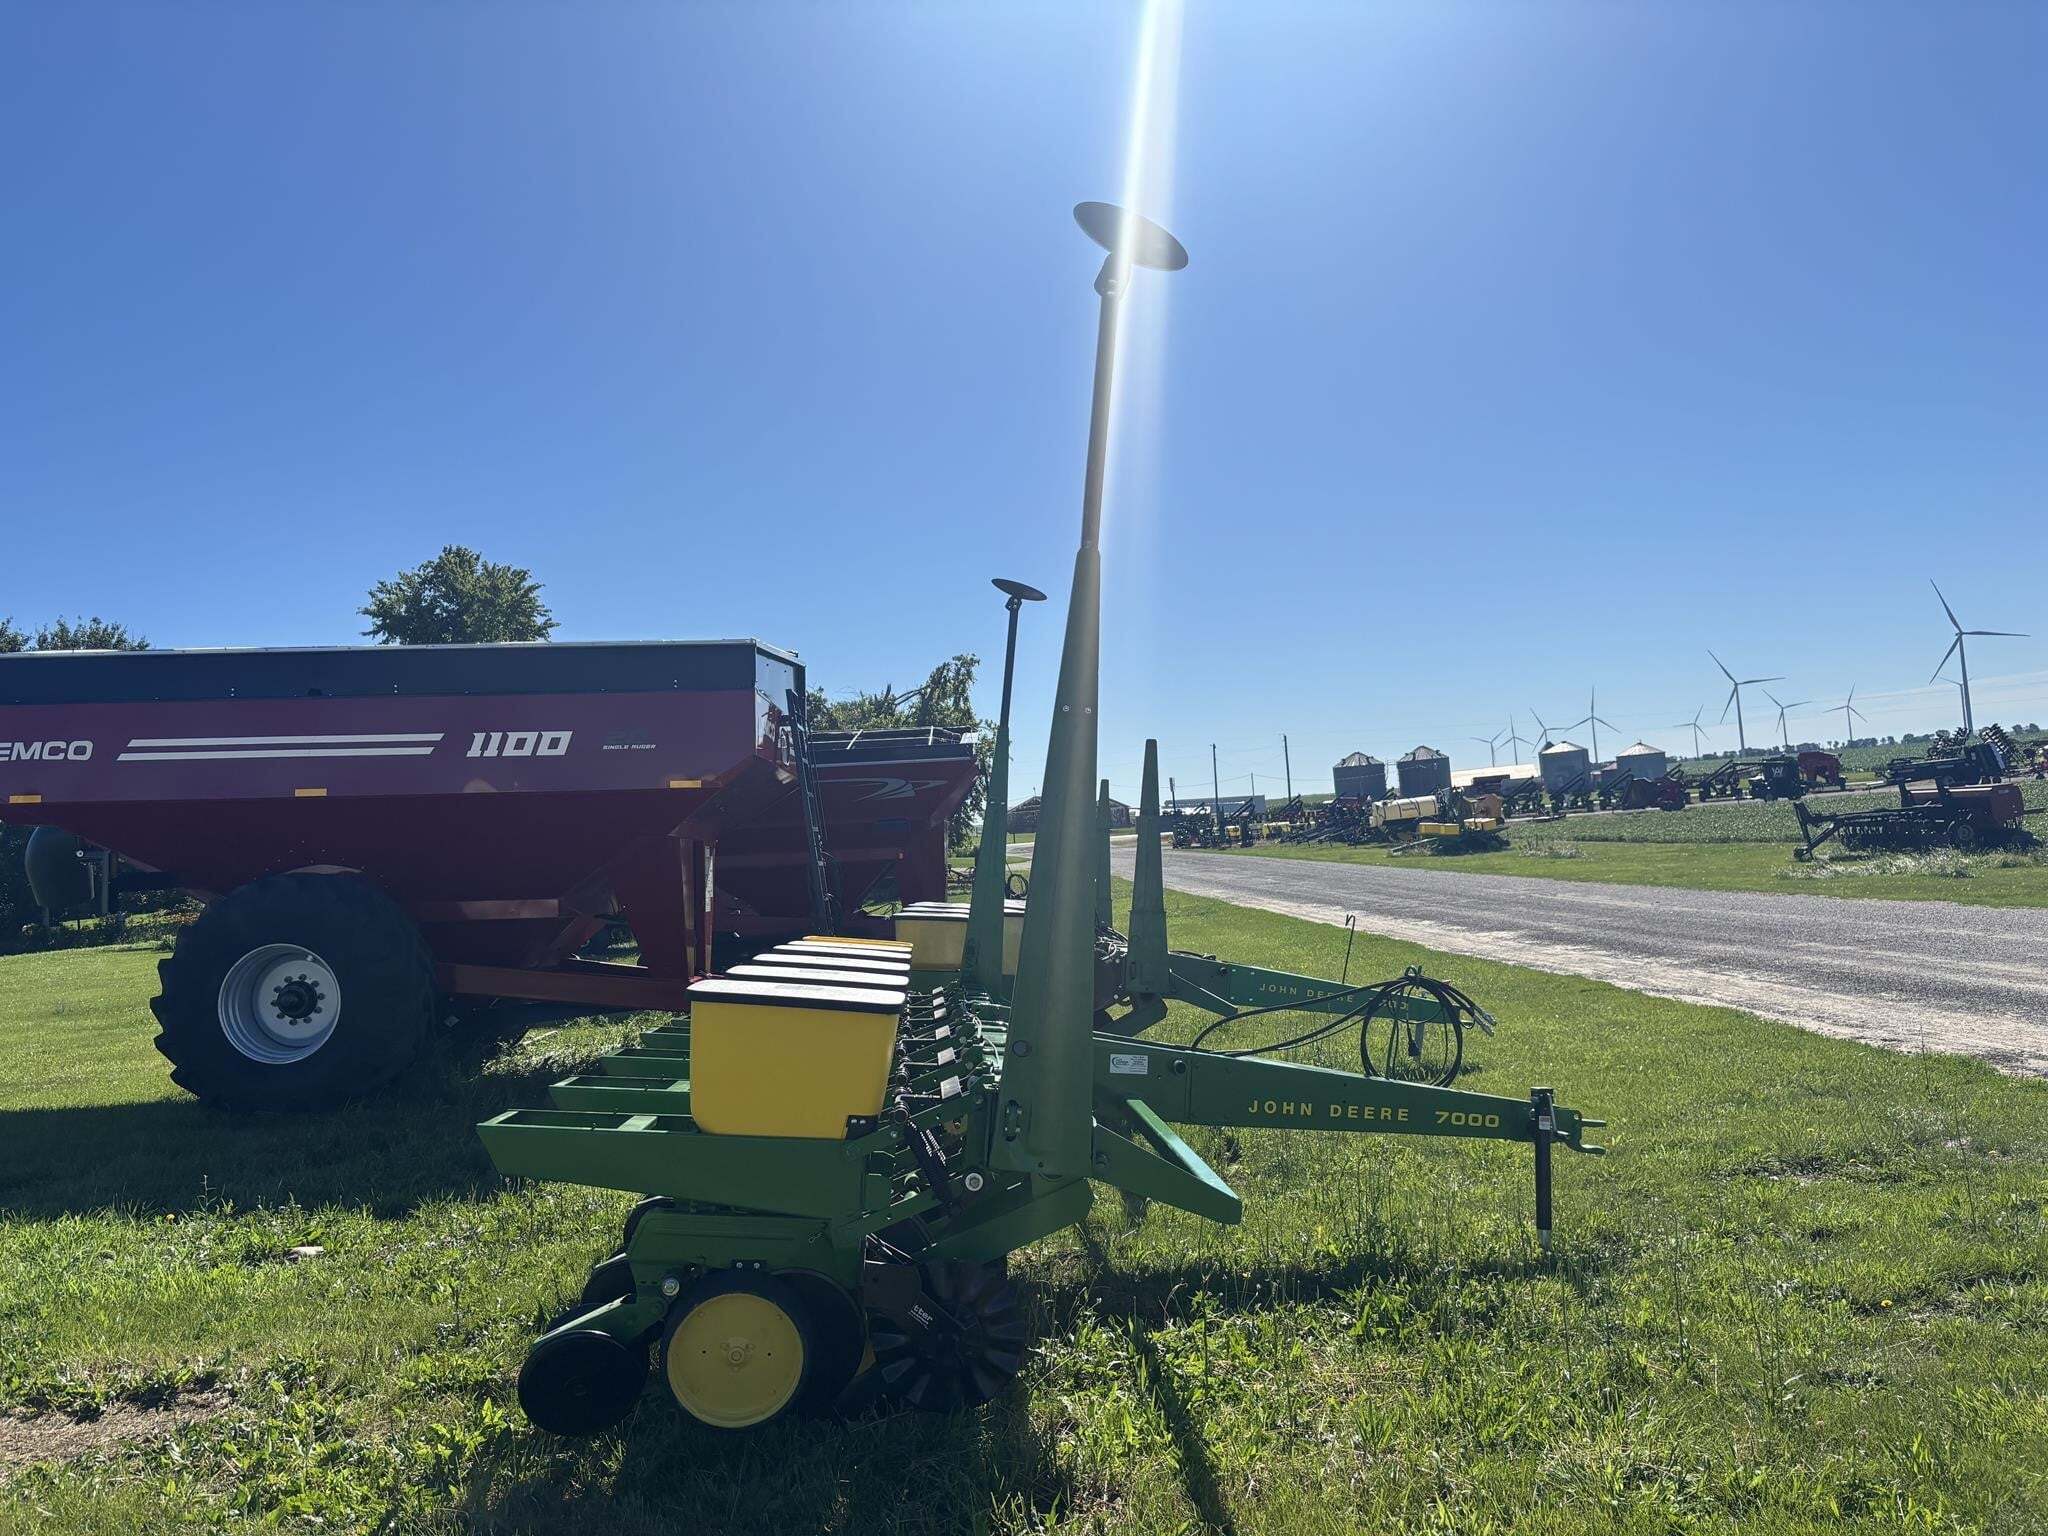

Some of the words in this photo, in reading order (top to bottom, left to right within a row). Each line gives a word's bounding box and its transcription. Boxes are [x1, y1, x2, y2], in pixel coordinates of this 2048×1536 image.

[466, 730, 574, 757] 1100
[1259, 983, 1297, 995] JOHN
[1248, 1100, 1313, 1117] JOHN
[1329, 1104, 1409, 1122] DEERE
[1434, 1111, 1500, 1128] 7000
